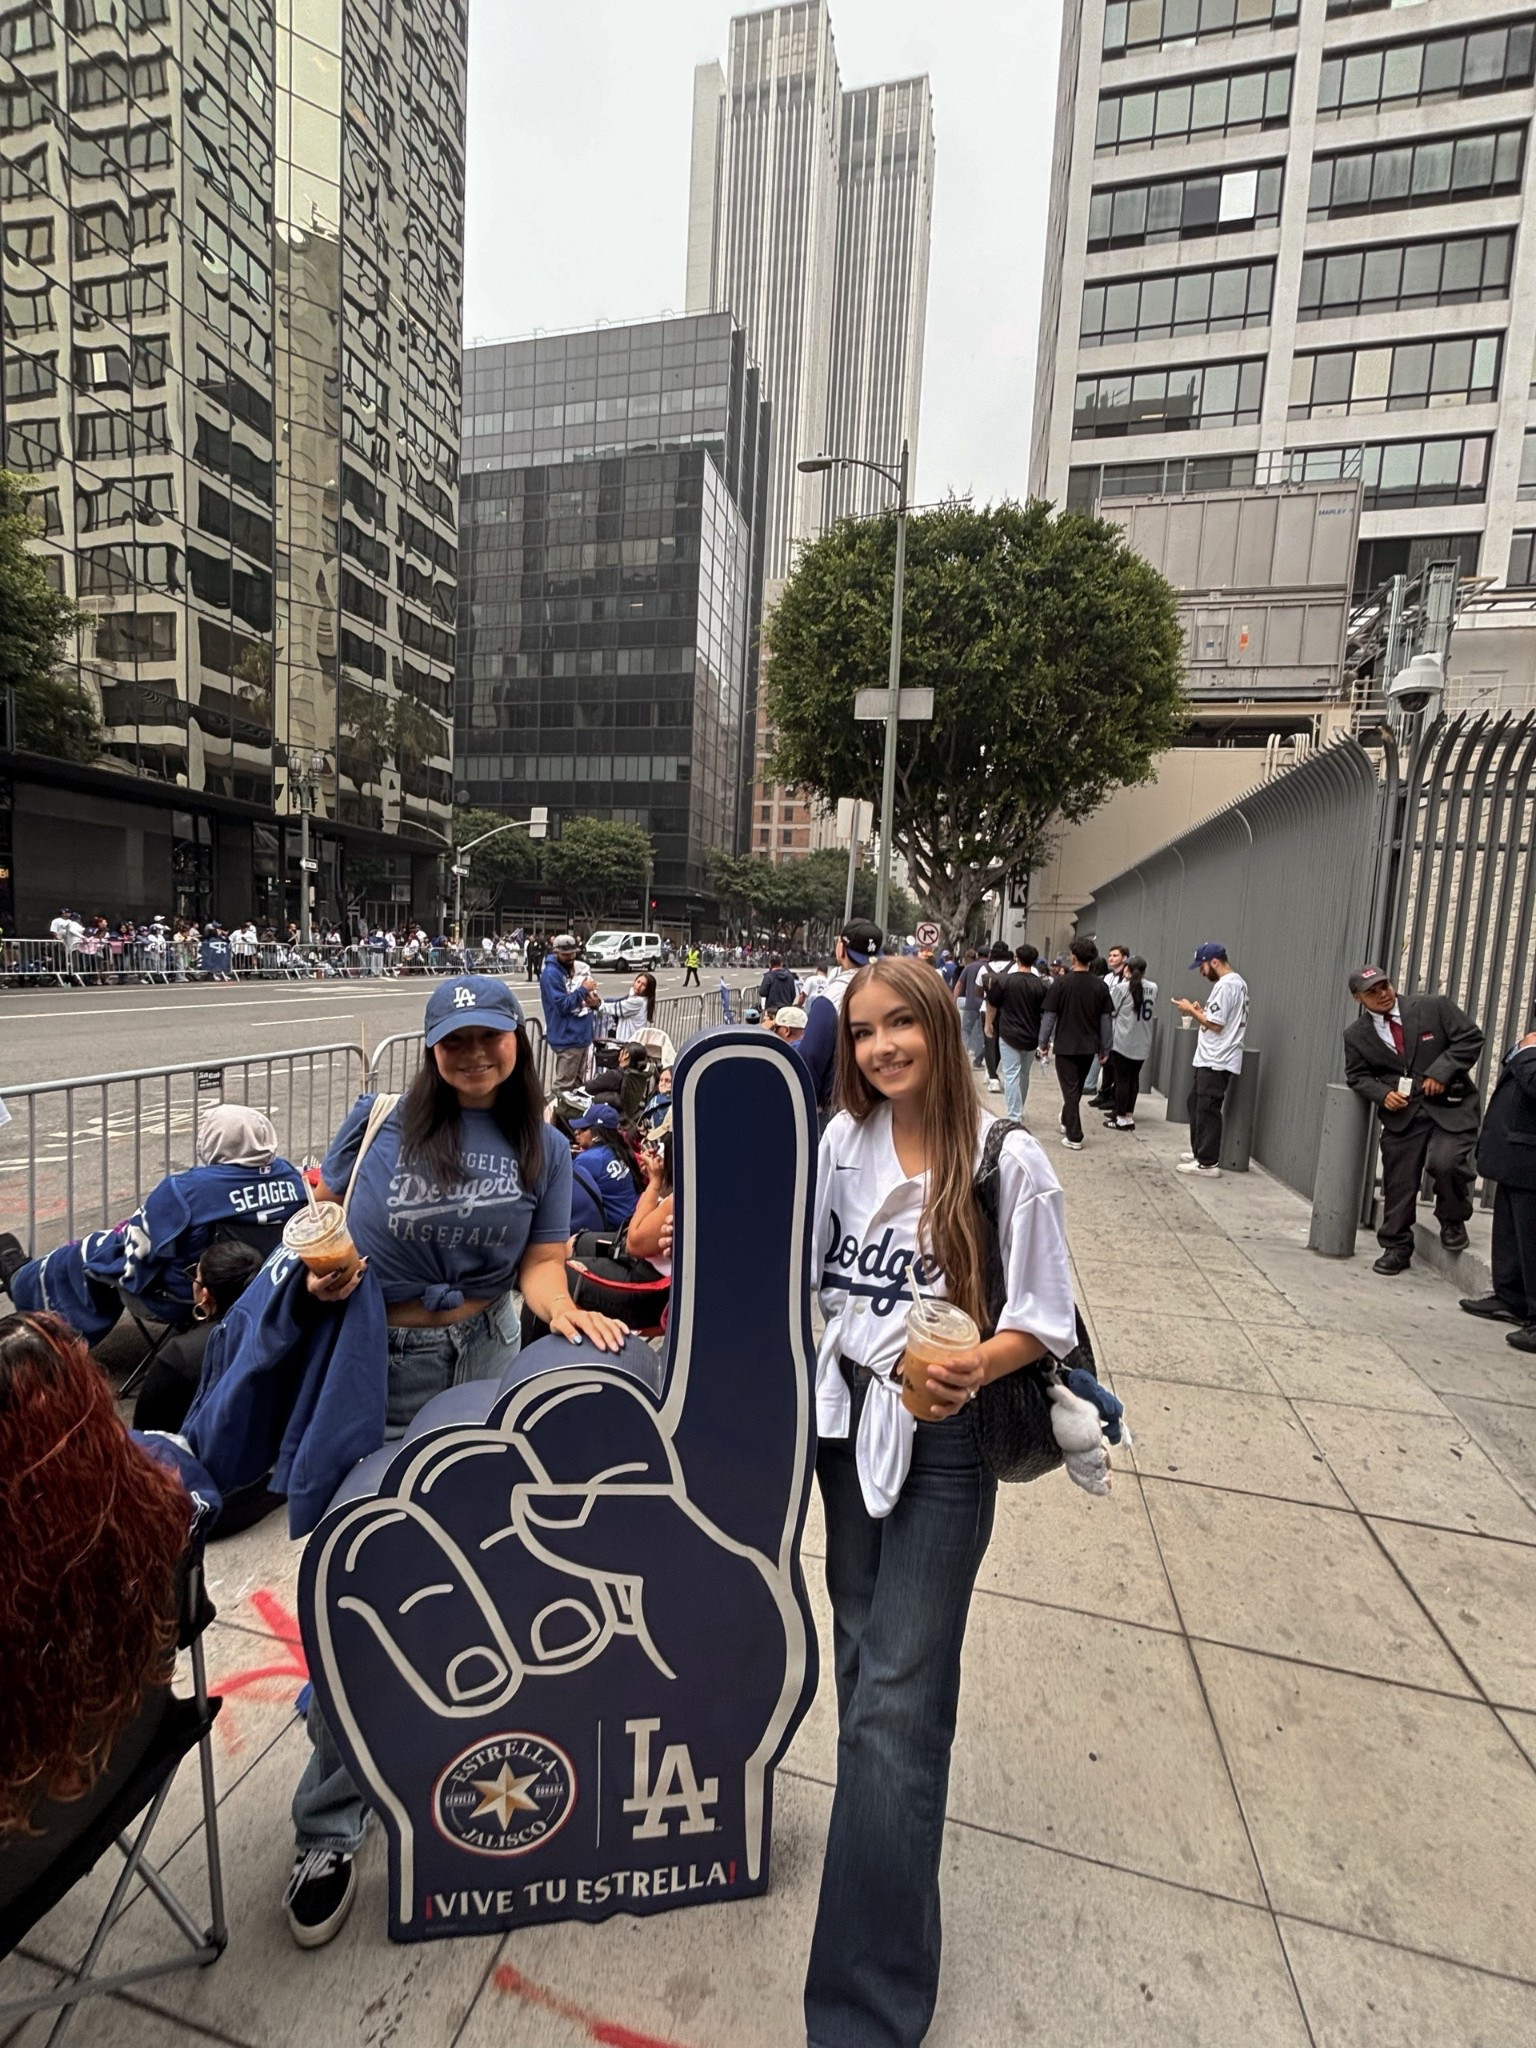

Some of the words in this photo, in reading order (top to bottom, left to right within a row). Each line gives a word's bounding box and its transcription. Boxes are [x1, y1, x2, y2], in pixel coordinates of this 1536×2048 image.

[453, 986, 476, 1008] LA
[228, 1180, 299, 1212] SEAGER
[824, 1208, 946, 1317] Dodge
[451, 1740, 558, 1783] ESTRELLA
[622, 1717, 719, 1840] LA
[461, 1820, 547, 1849] JALISCO
[523, 1878, 567, 1906] TU
[576, 1860, 737, 1905] ESTRELLA!
